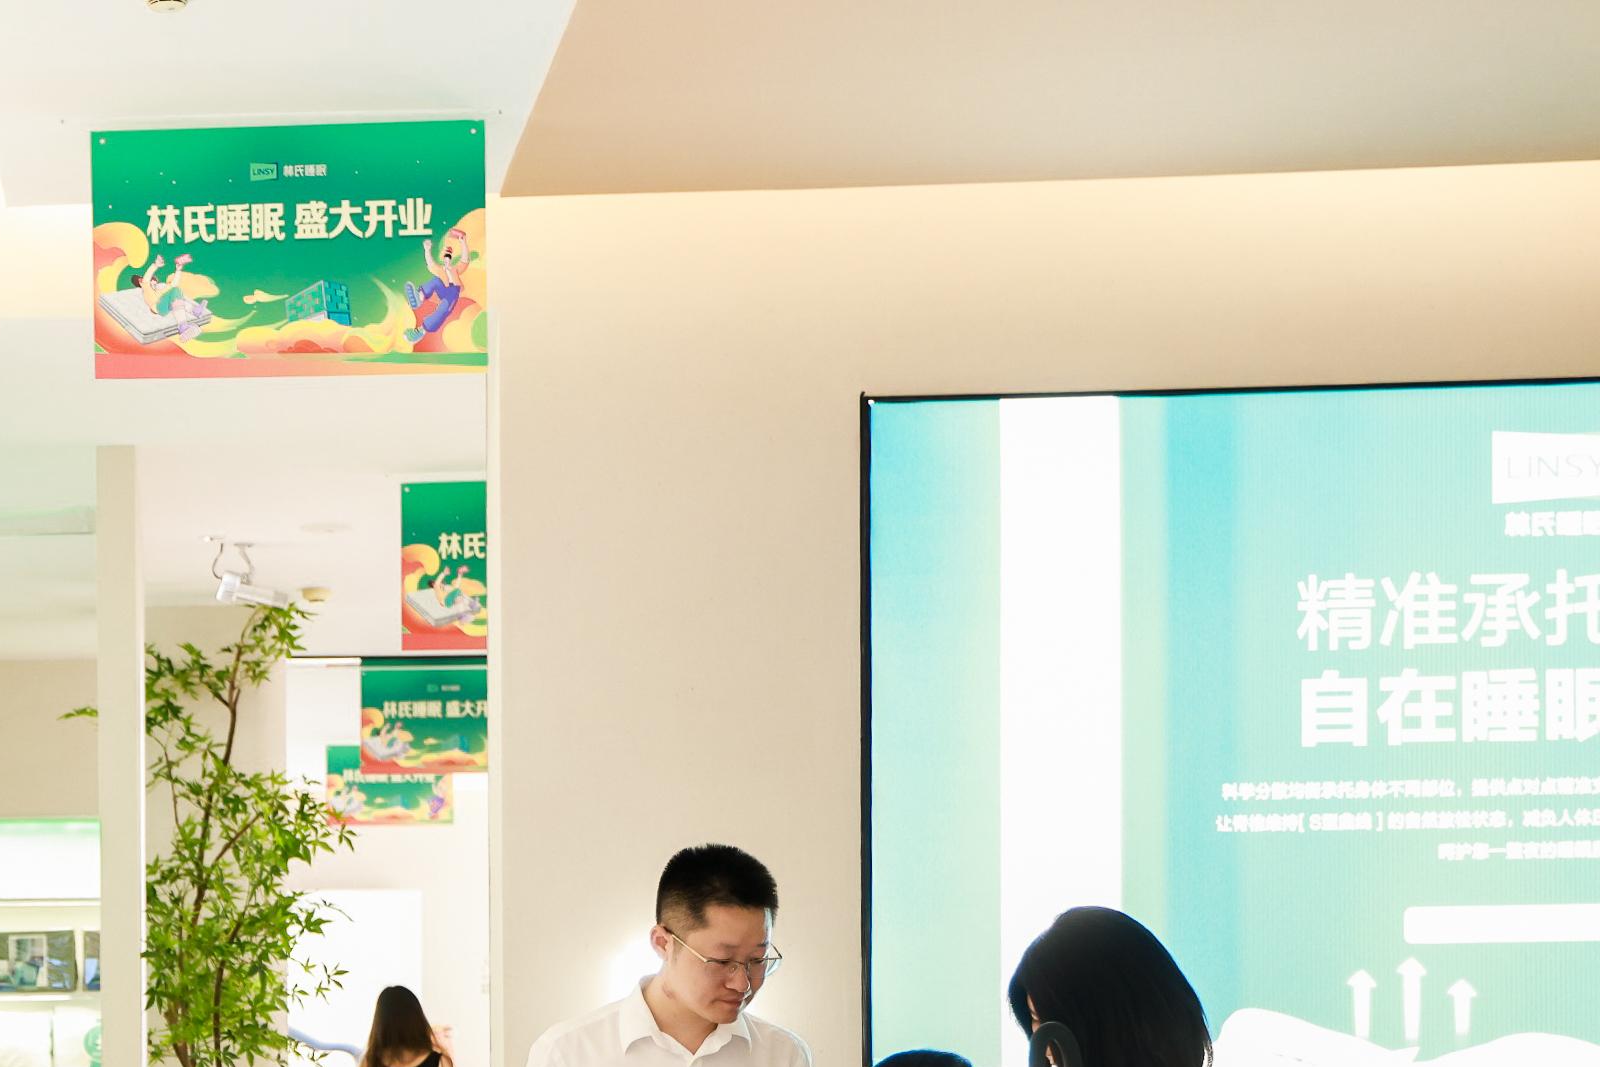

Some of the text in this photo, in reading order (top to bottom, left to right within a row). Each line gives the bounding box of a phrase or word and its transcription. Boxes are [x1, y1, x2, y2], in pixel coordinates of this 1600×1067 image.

[146, 198, 433, 245] 林氏睡眠 盛大开业
[1297, 568, 1600, 651] 精准承托
[1300, 668, 1600, 747] 自在睡眠
